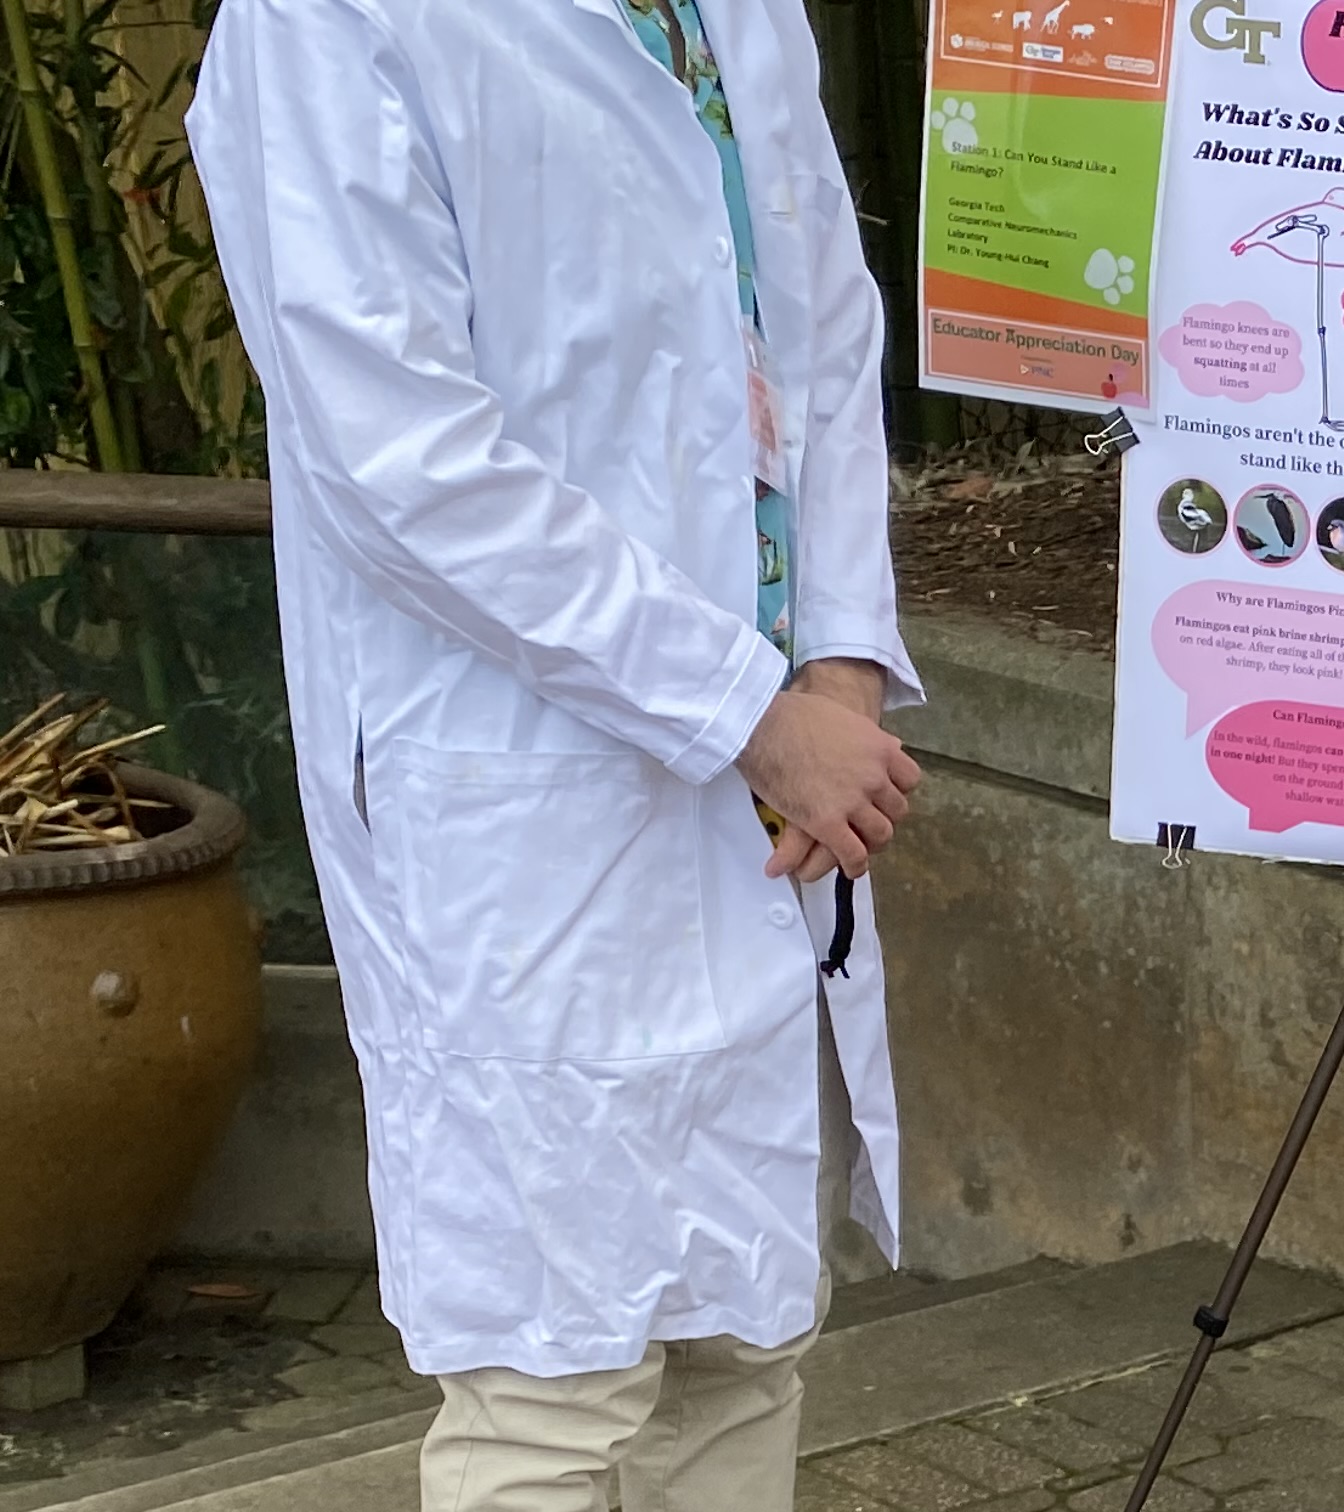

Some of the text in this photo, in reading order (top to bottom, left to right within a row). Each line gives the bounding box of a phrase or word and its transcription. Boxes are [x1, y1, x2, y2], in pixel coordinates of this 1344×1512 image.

[1203, 102, 1292, 129] What's
[1297, 112, 1330, 132] So
[952, 141, 988, 156] Station
[1004, 149, 1023, 162] Can
[1027, 152, 1048, 165] You
[1051, 156, 1083, 170] Stand
[1086, 161, 1108, 173] Like
[1110, 166, 1117, 174] a
[1194, 140, 1273, 166] About
[950, 161, 1004, 178] Flamingo?
[933, 318, 1139, 366] Educator Appreciation Day
[1164, 415, 1250, 438] Flamingos
[1255, 426, 1304, 444] aren't
[1308, 431, 1335, 447] the
[1240, 452, 1286, 470] stand
[1291, 456, 1322, 474] like
[1216, 591, 1242, 606] Why
[1246, 597, 1264, 609] are
[1267, 598, 1326, 616] Flamingos
[1175, 616, 1231, 632] Flamingos
[1233, 623, 1249, 633] eat
[1252, 624, 1276, 638] pink
[1278, 627, 1306, 641] brine
[1273, 709, 1295, 721] Can
